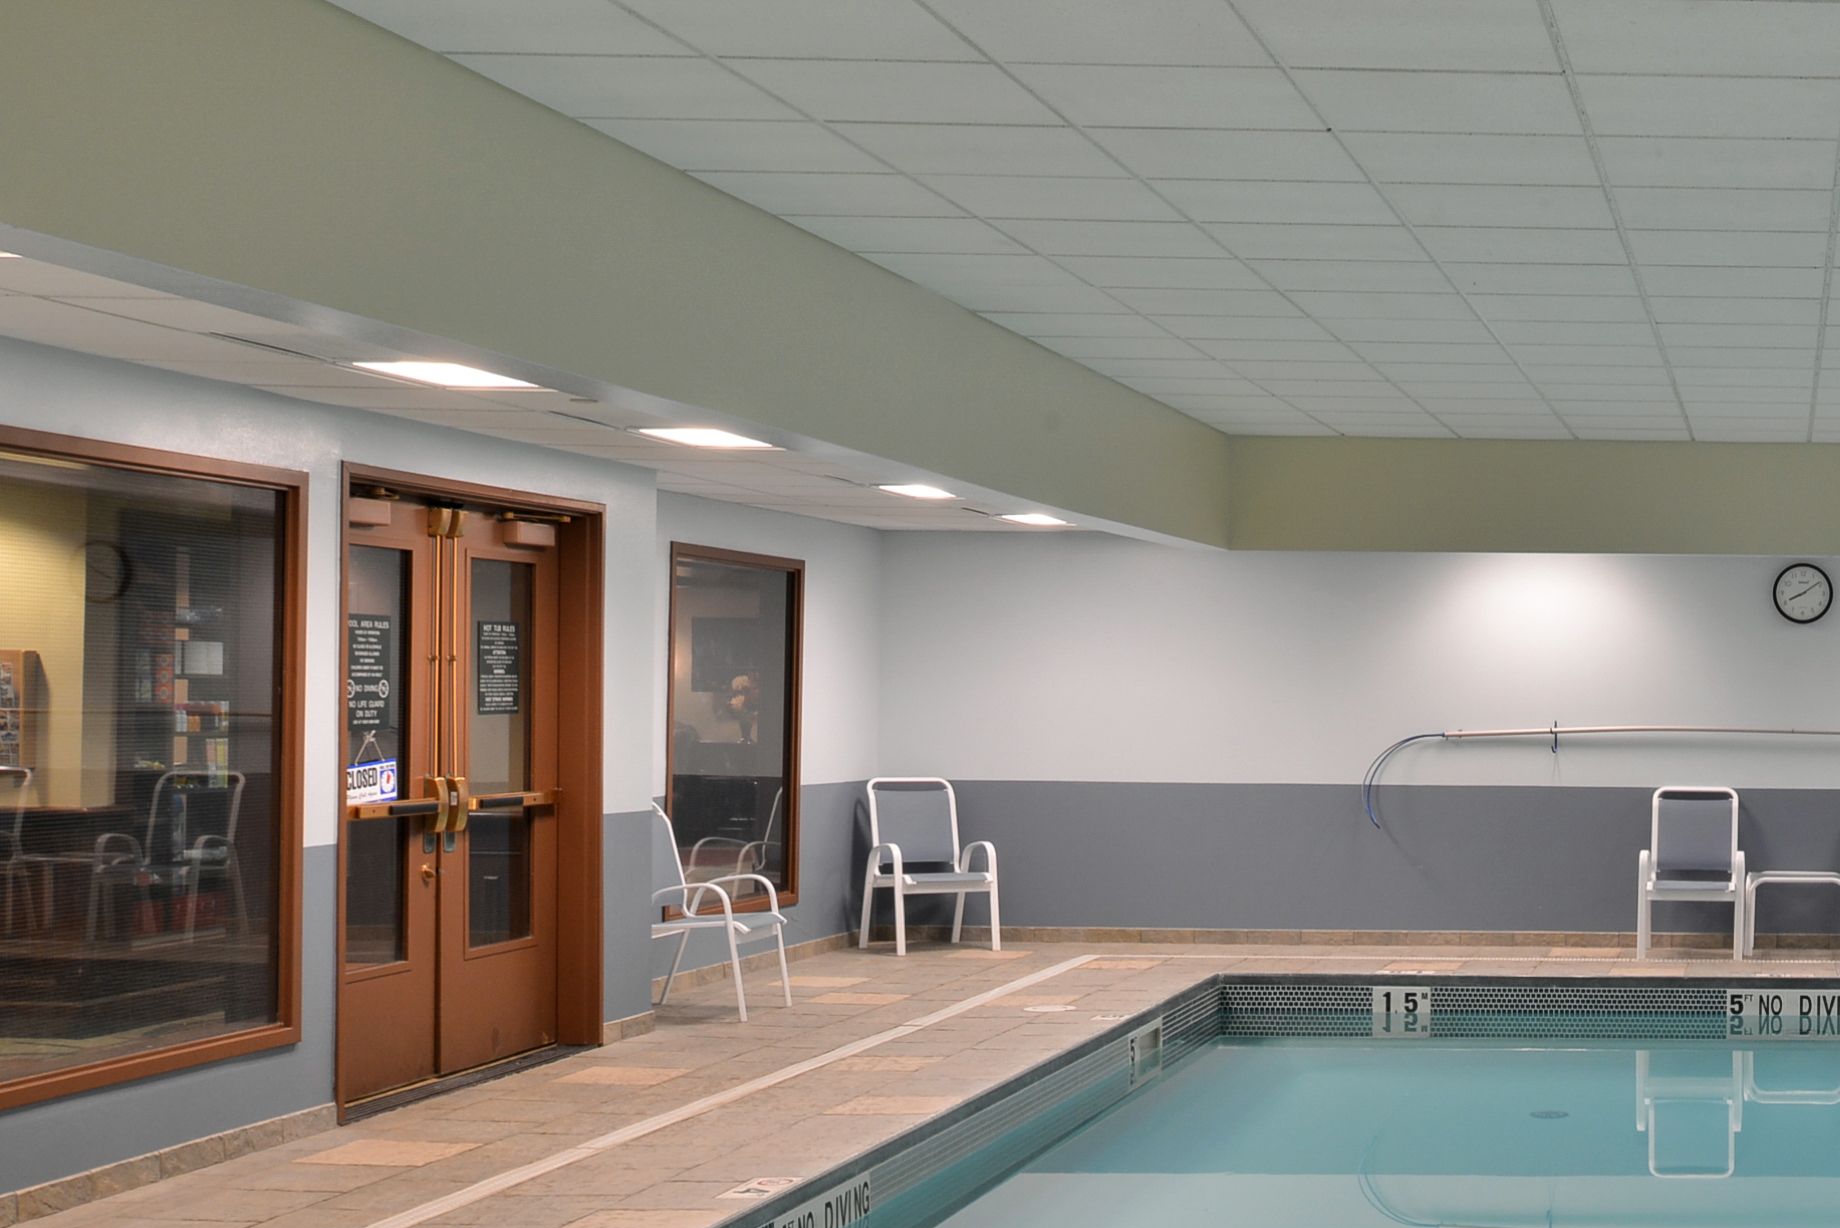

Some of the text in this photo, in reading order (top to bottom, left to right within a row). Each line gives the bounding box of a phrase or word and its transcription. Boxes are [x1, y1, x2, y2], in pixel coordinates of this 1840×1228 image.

[348, 620, 359, 628] OOL
[346, 767, 377, 791] CLOSED
[1758, 994, 1783, 1016] NO
